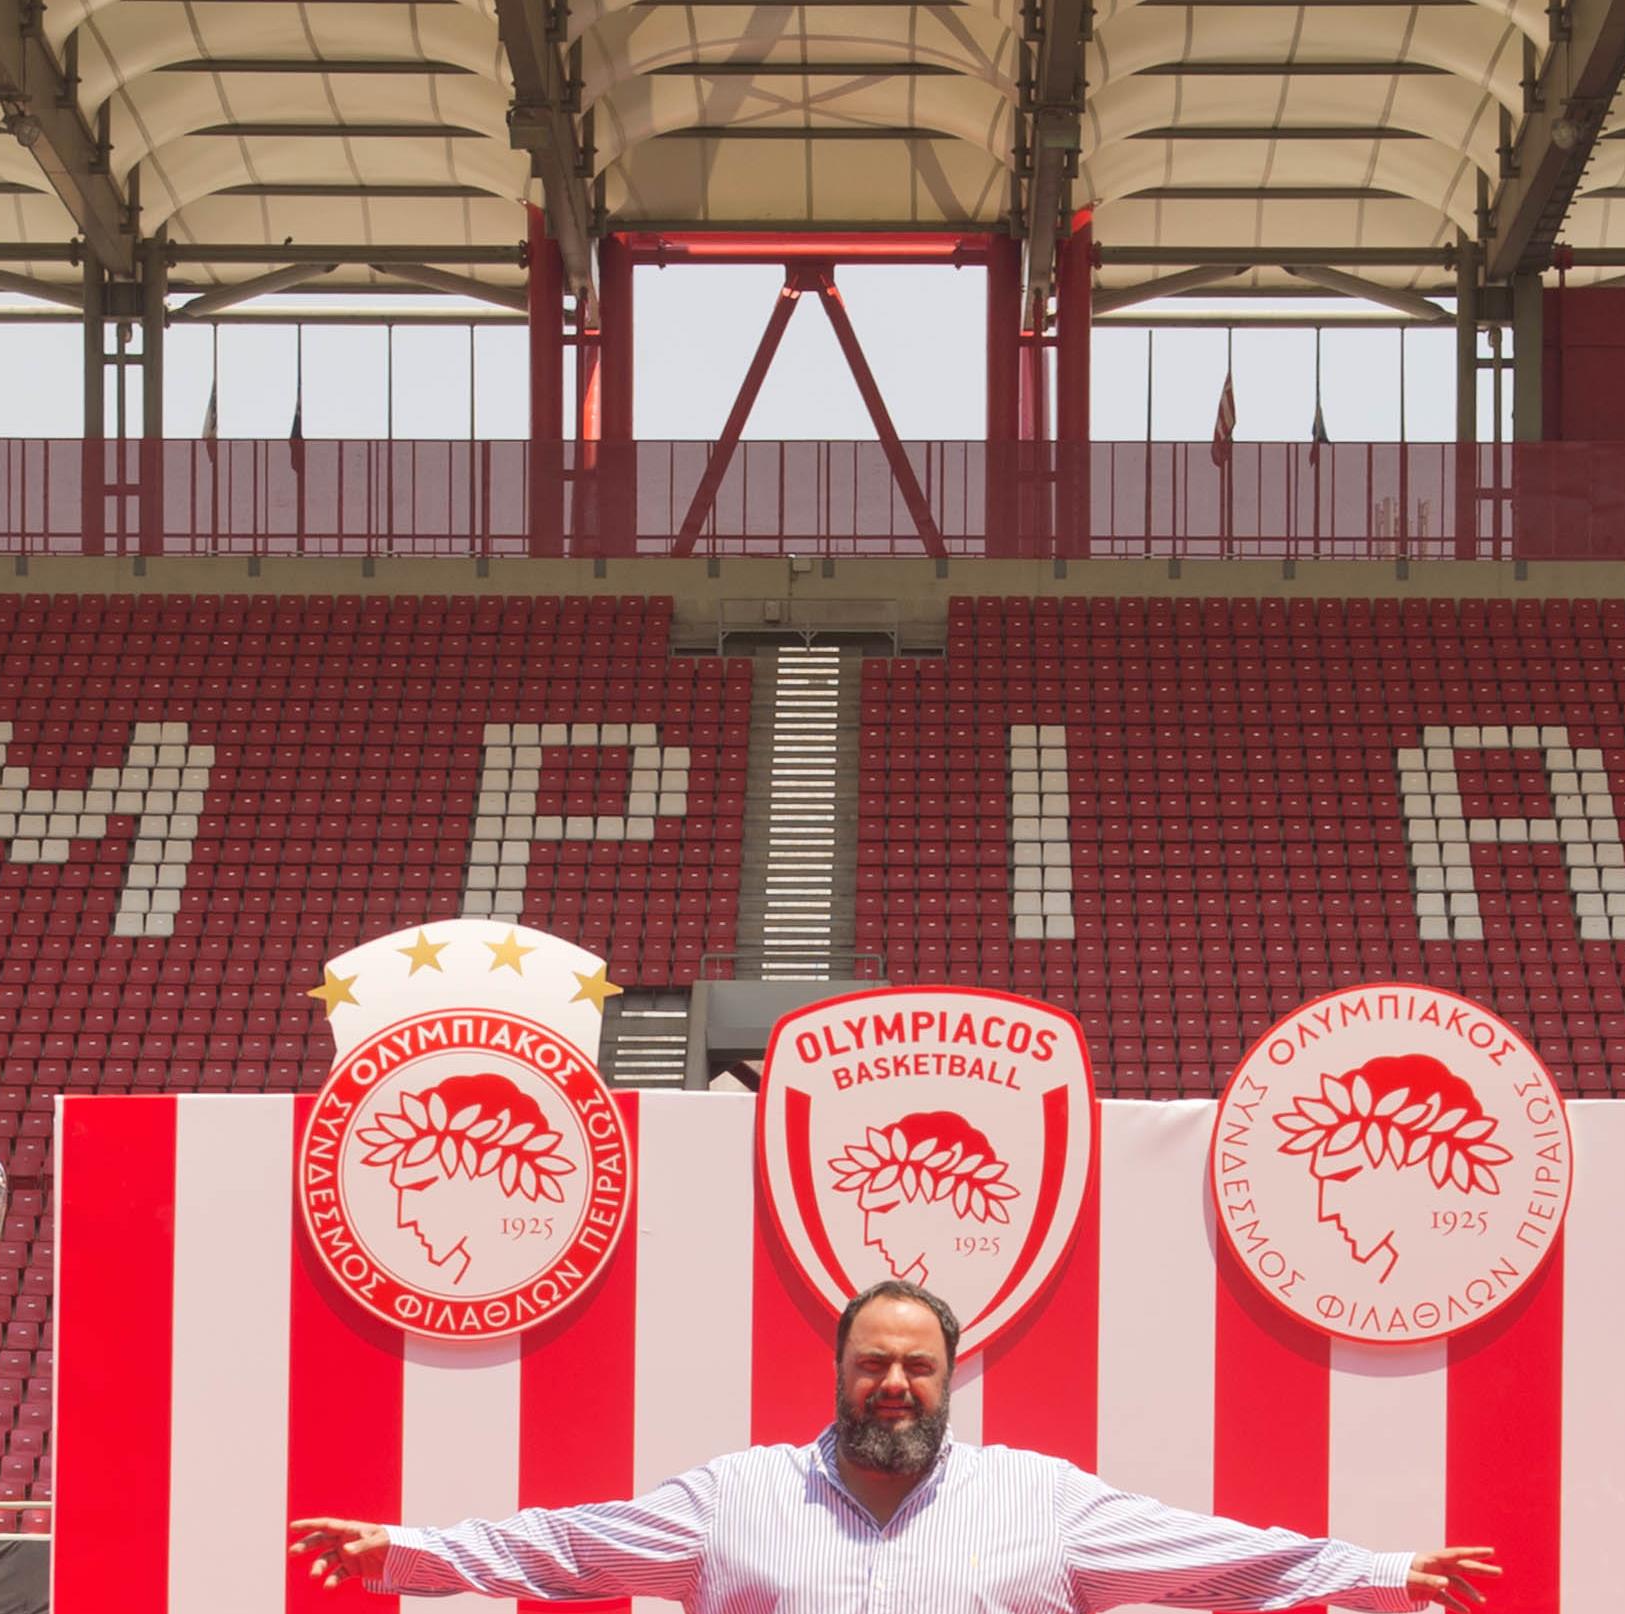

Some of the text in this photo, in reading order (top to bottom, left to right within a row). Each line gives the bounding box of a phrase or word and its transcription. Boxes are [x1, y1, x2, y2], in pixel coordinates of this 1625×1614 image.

[351, 1019, 581, 1086] ΟΛΥΜΠΙΑΚΟΣ
[796, 1011, 1058, 1064] OLYMPIACOS
[1268, 995, 1516, 1066] ΟΛΥΜΠΙΑΚΟΣ
[832, 1053, 1021, 1090] BASKETBALL
[308, 1090, 624, 1330] ΣΥΝΔΕΣΜΟΣ ΦΙΛΑΘΛΩΝ ΠΕΙΡΑΙΩΣ
[501, 1217, 553, 1239] 1925
[1222, 1073, 1562, 1332] ΣΥΝΔΕΣΜΟΣ ΦΙΛΑΘΛΩΝ ΠΕΙΡΑΙΩΣ
[1431, 1211, 1488, 1236] 1925
[955, 1237, 1000, 1256] 1925
